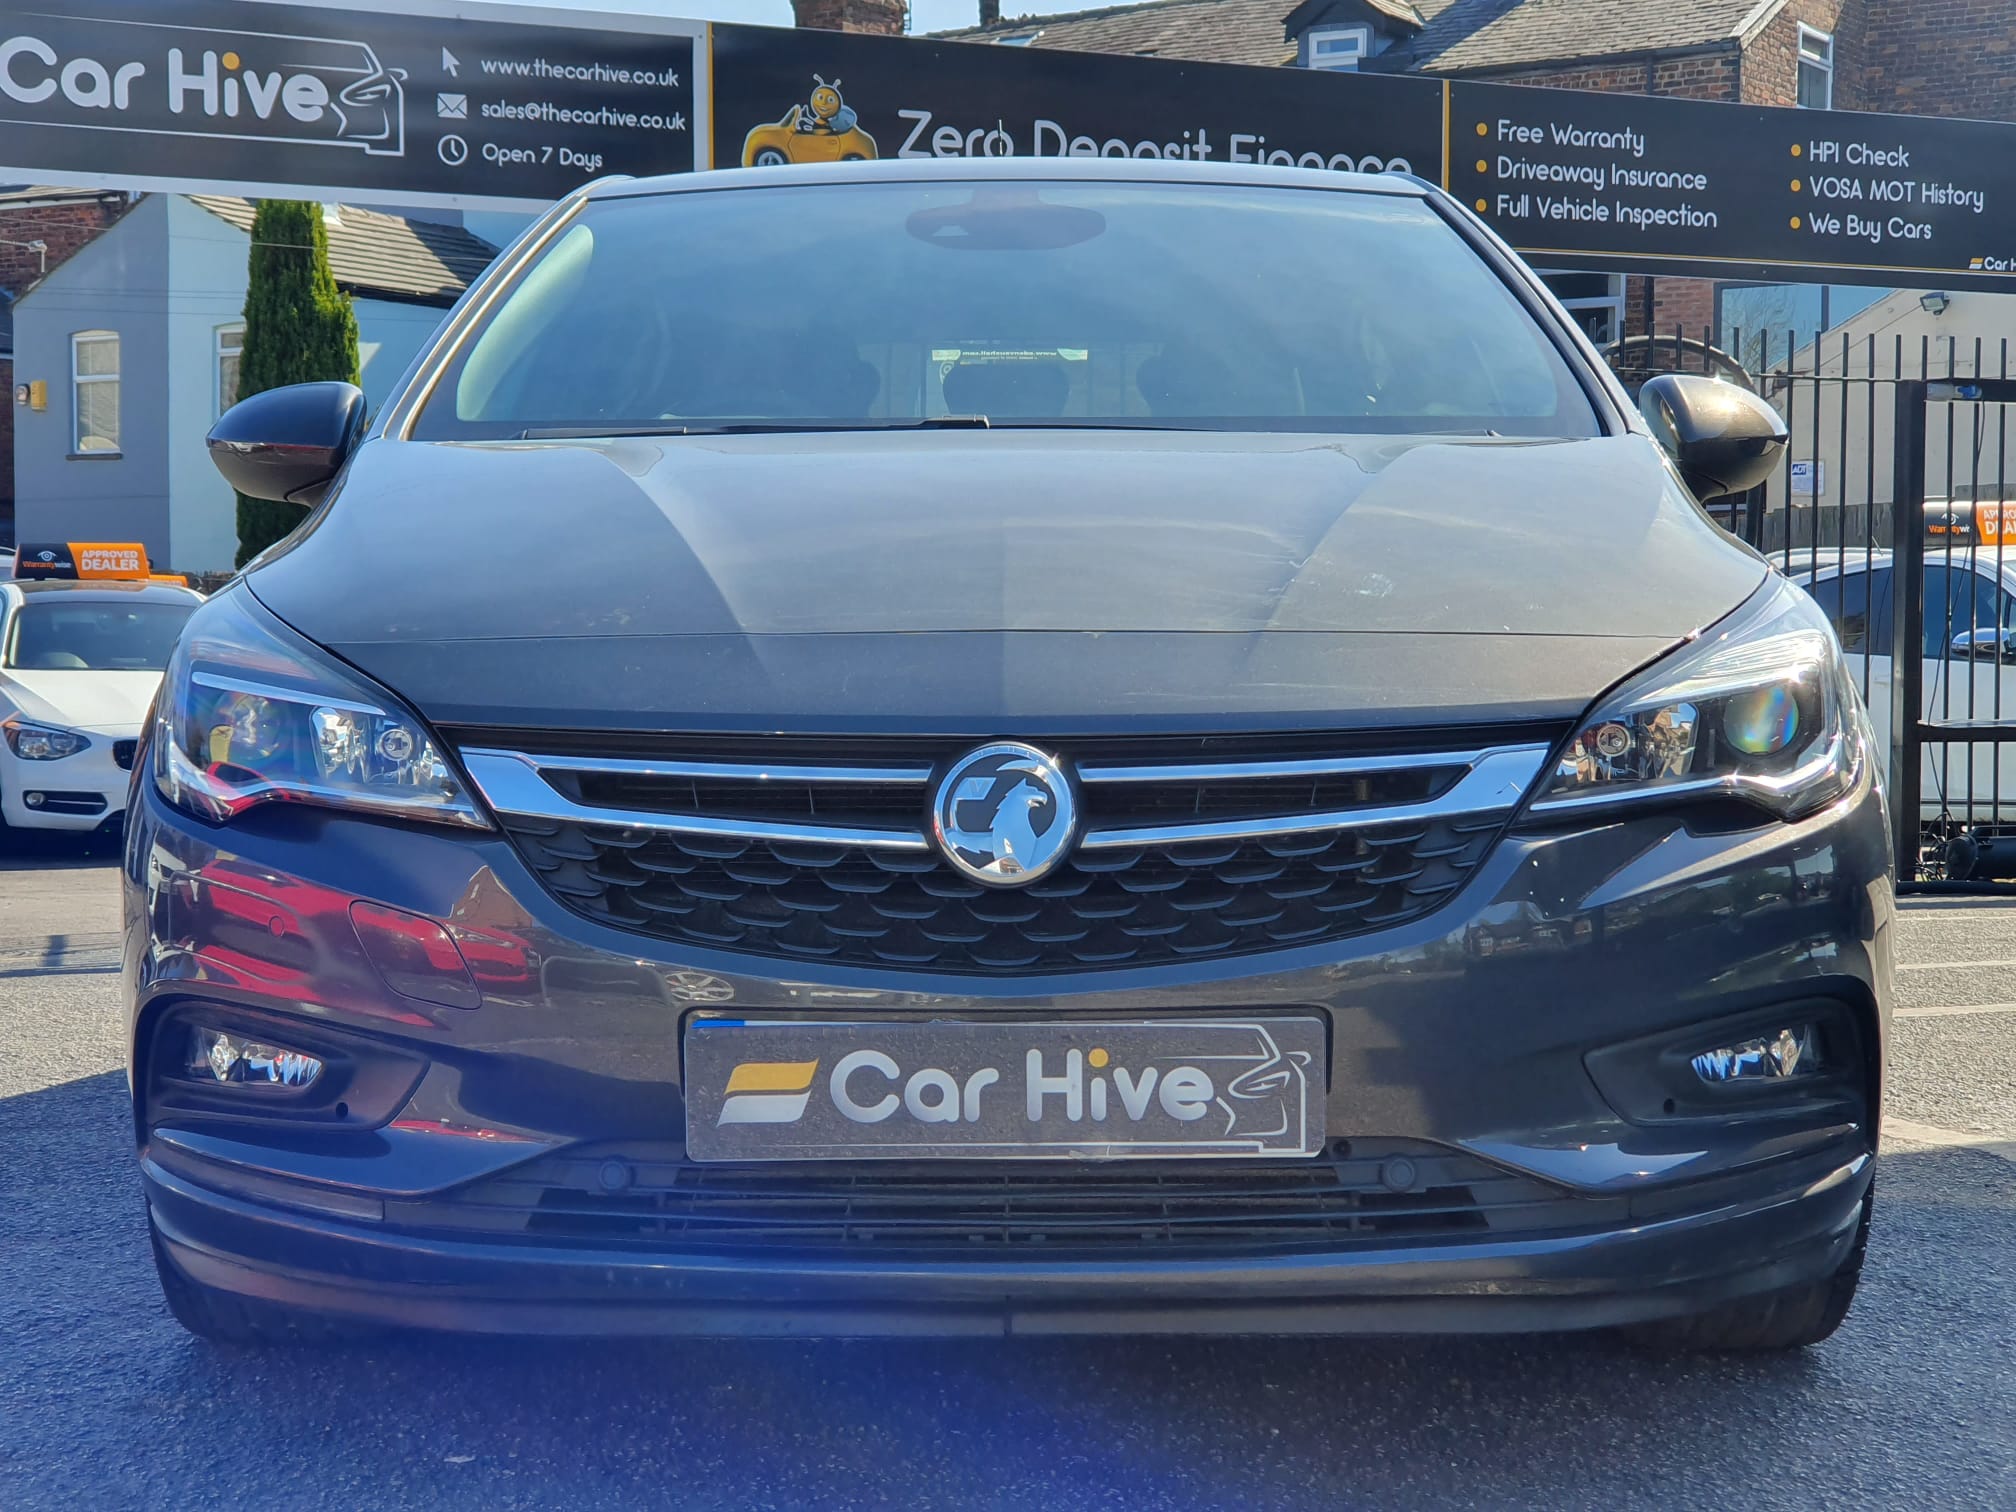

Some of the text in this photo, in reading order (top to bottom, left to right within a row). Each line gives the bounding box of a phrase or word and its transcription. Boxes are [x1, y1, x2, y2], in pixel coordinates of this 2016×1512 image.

[0, 36, 329, 122] Car Hive
[481, 58, 679, 87] www.thecarhive.co.uk
[481, 99, 686, 130] sales@thecarhive.co.uk
[898, 109, 1014, 158] Zero
[1497, 119, 1645, 158] Free Warranty
[482, 143, 603, 172] Open 7 Days
[1809, 140, 1910, 167] HPI Check
[1497, 156, 1708, 191] Driveaway Insurance
[1809, 175, 1984, 213] VOSA MOT History
[1497, 194, 1718, 231] Full Vehicle Inspection
[1808, 212, 1932, 244] We Buy Cars
[1984, 256, 2008, 271] Car
[81, 550, 138, 559] APPROVED
[81, 559, 139, 570] DEALER
[829, 1048, 1214, 1123] Car Hive
